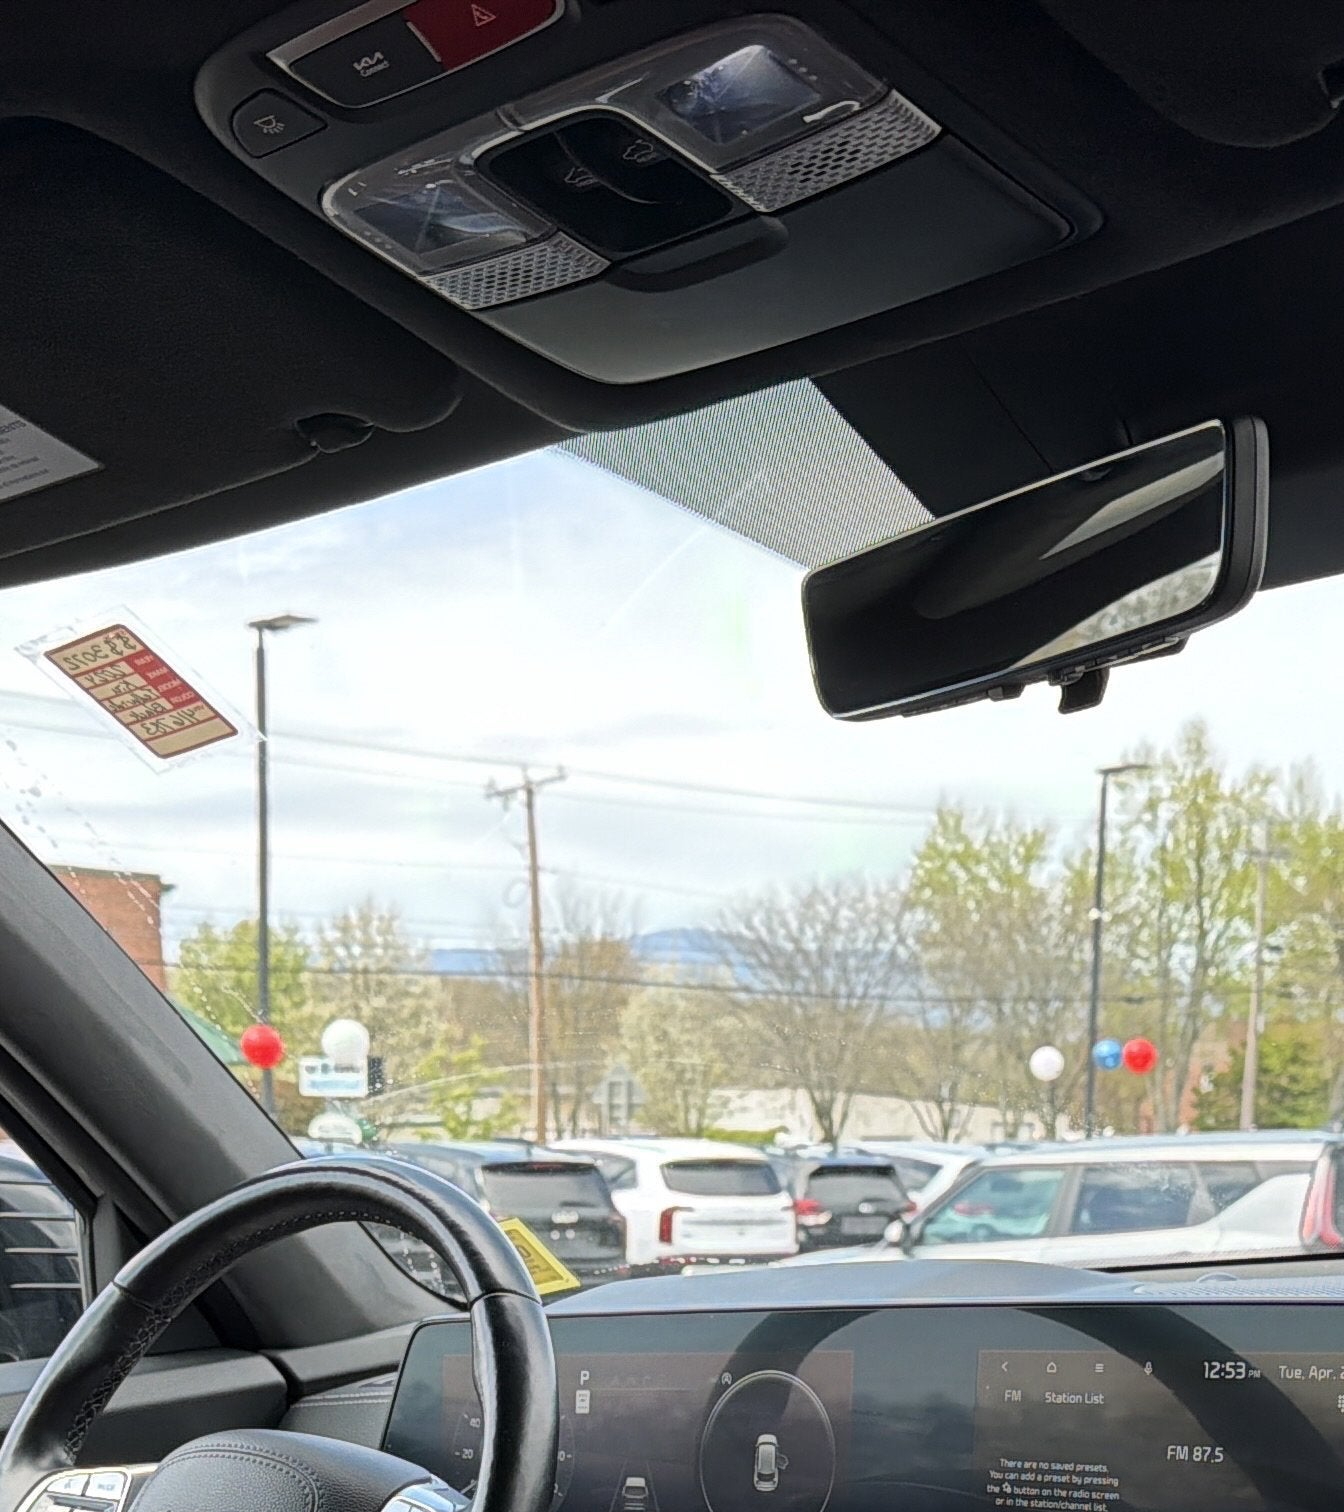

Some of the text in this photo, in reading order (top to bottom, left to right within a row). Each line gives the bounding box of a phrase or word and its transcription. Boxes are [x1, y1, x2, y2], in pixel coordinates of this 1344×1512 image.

[580, 1370, 590, 1385] P
[1204, 1361, 1246, 1379] 12:53
[1248, 1370, 1261, 1379] PM
[1308, 1365, 1337, 1381] Apr.
[1004, 1390, 1104, 1405] FM Station List
[462, 1448, 474, 1459] 20
[1166, 1445, 1224, 1463] FM 87.5
[1000, 1458, 1022, 1468] There
[1023, 1461, 1037, 1469] are
[1039, 1461, 1049, 1470] no
[1051, 1462, 1075, 1471] saved
[989, 1470, 1004, 1479] You
[1004, 1471, 1019, 1480] can
[1020, 1472, 1035, 1481] add
[1043, 1474, 1071, 1484] preset
[1072, 1475, 1082, 1485] by
[1083, 1476, 1119, 1487] pressing
[986, 1484, 1120, 1500] the button on the radio screen
[995, 1498, 1005, 1506] or
[1006, 1497, 1014, 1506] in
[1015, 1498, 1029, 1507] the
[1030, 1499, 1092, 1511] station/channel
